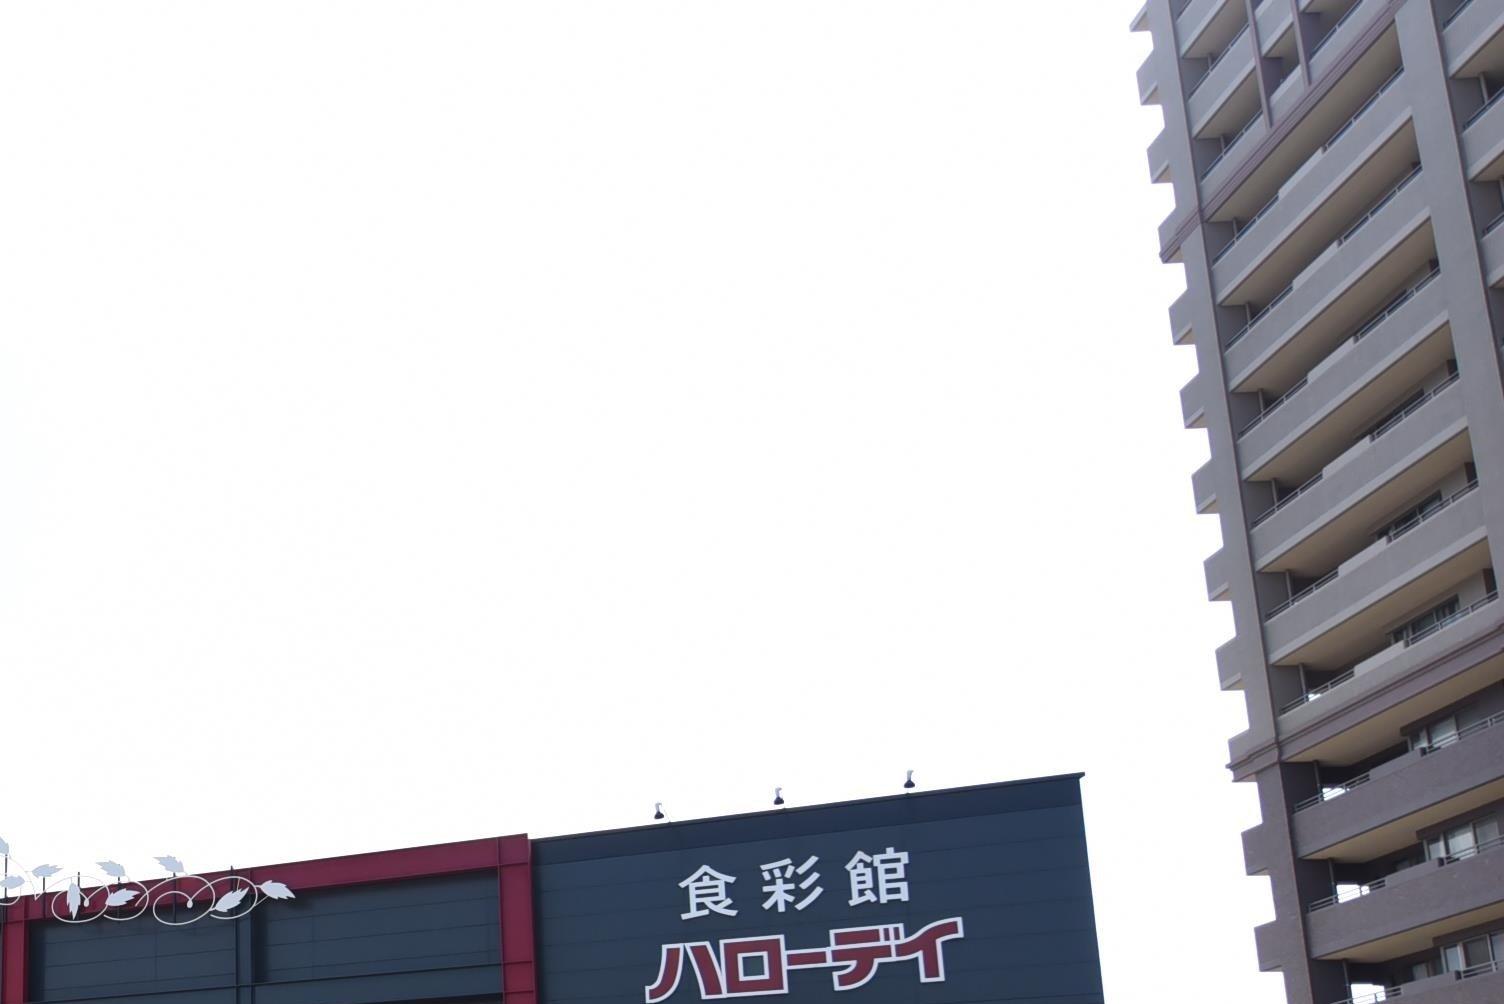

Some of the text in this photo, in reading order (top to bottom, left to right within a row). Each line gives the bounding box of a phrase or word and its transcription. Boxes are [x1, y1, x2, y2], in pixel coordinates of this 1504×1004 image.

[679, 848, 909, 920] 食彩館
[645, 917, 963, 1003] ハローデイ
